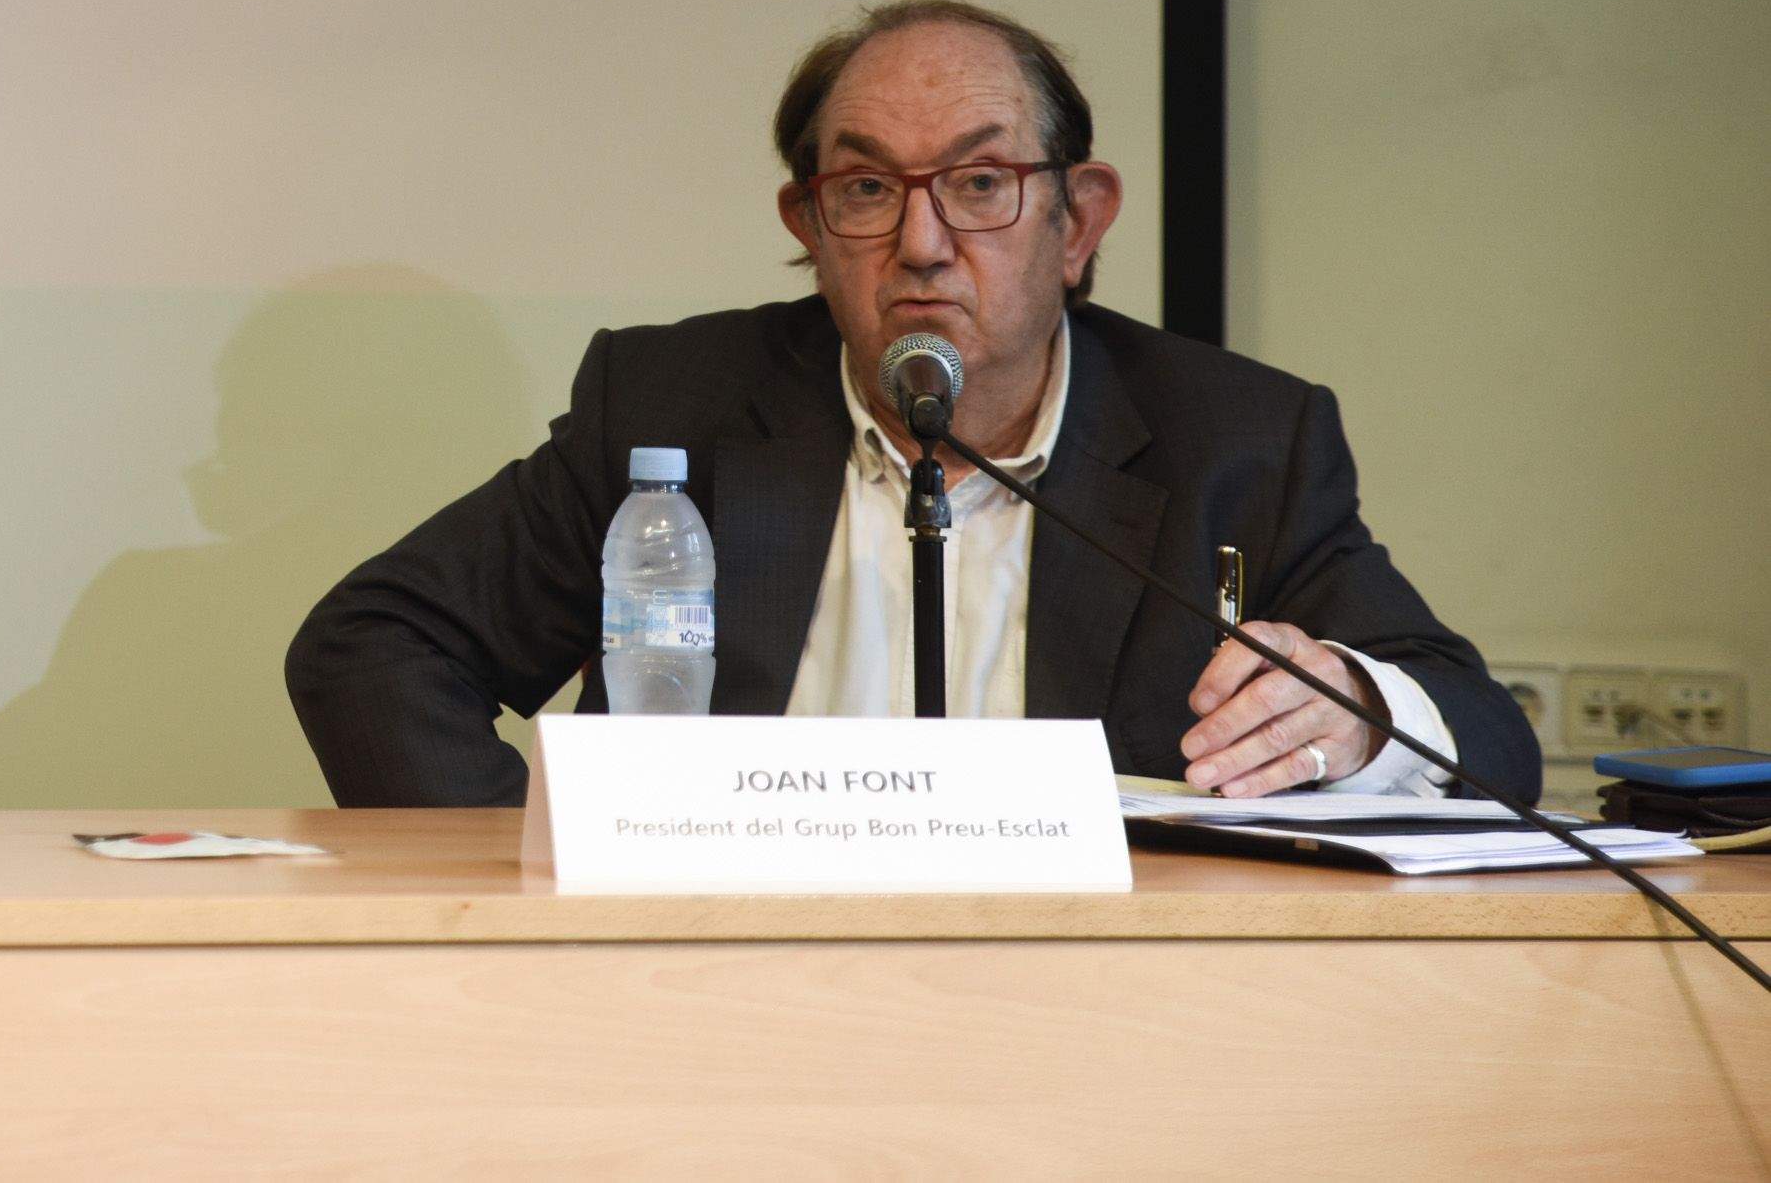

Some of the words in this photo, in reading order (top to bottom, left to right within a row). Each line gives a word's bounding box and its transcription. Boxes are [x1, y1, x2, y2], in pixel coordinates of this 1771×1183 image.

[732, 770, 827, 794] JOAN
[843, 770, 938, 794] FONT
[615, 817, 735, 837] President
[746, 817, 784, 837] del
[793, 818, 858, 842] Grup
[868, 818, 918, 838] Bon
[928, 818, 1072, 839] Preu-Esclat
